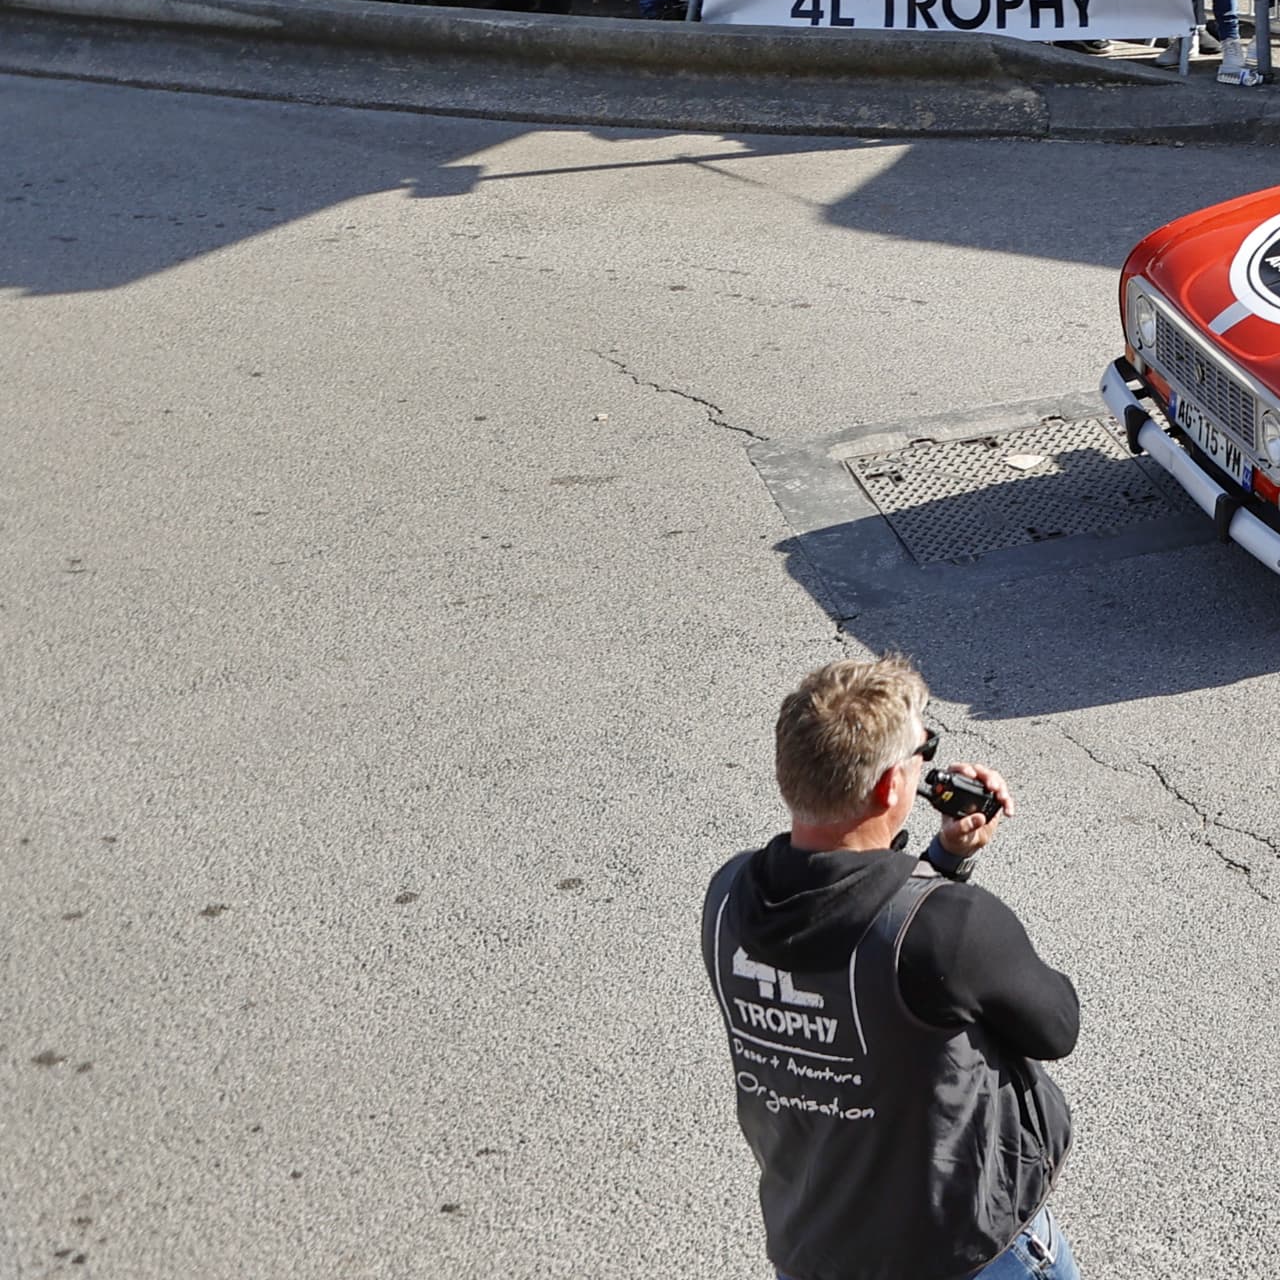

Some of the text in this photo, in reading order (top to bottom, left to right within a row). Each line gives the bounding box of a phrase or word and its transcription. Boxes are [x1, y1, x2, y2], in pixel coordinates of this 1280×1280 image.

[734, 997, 839, 1045] TROPHY
[732, 1038, 863, 1088] Desert Aventure
[736, 1071, 877, 1120] Organisation
